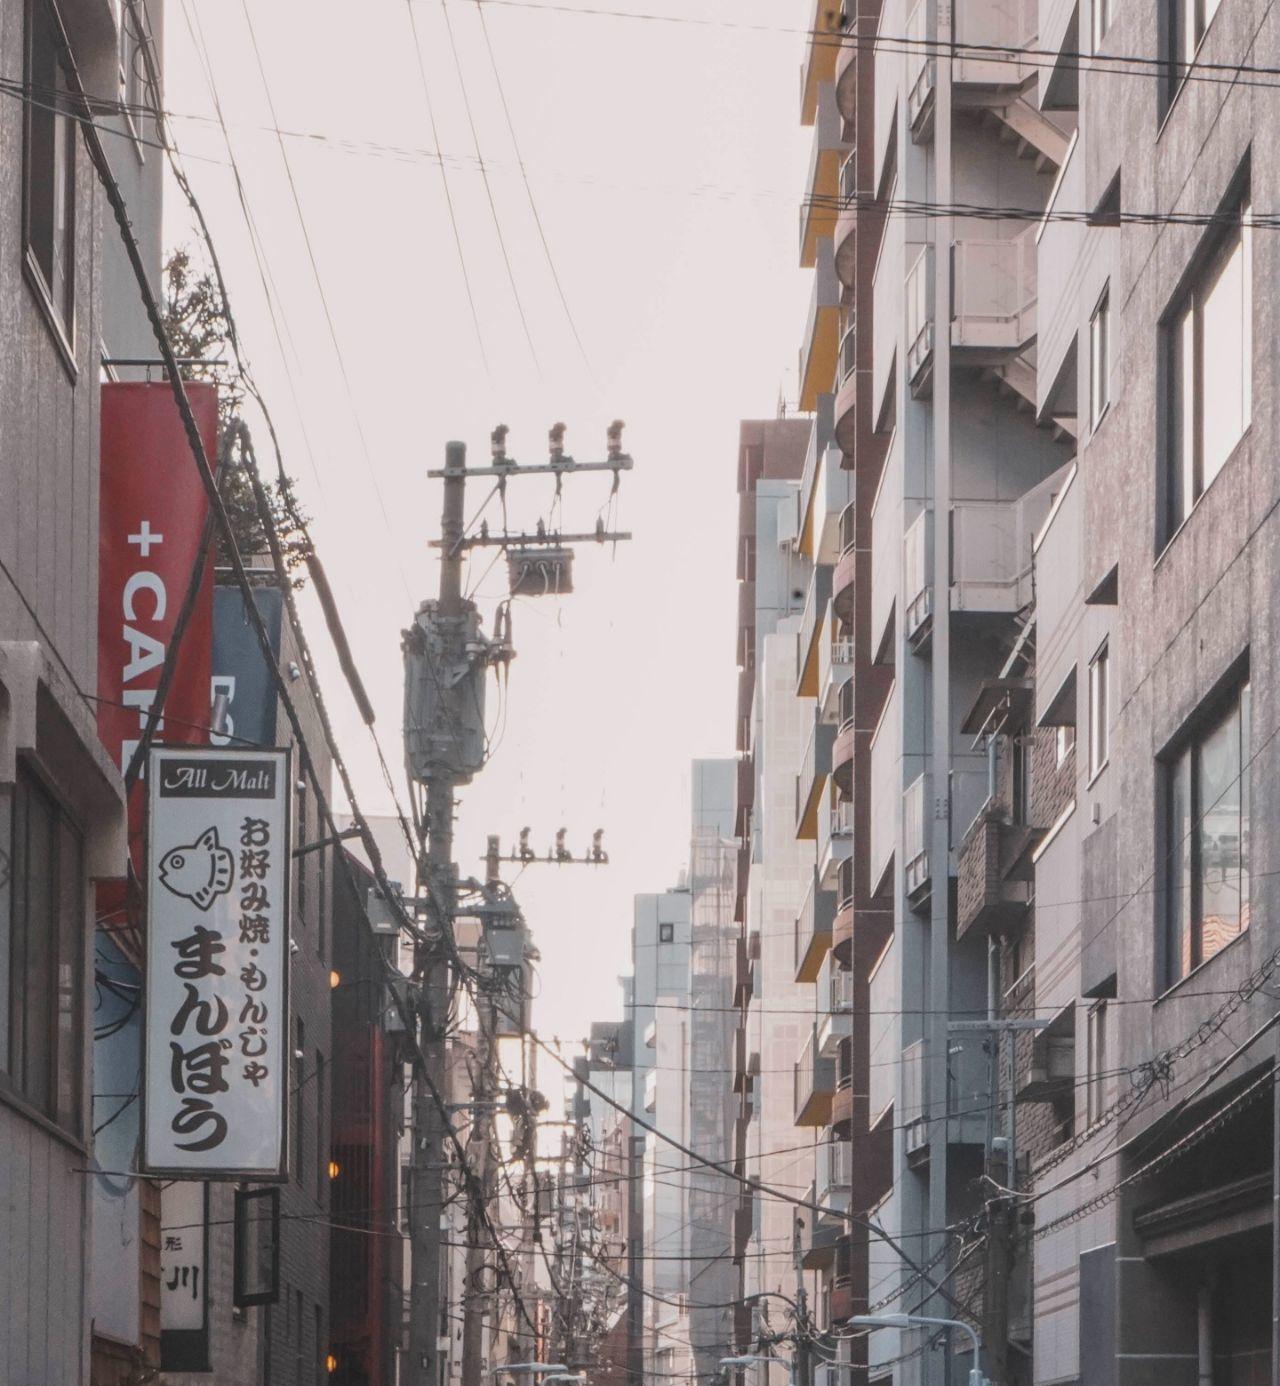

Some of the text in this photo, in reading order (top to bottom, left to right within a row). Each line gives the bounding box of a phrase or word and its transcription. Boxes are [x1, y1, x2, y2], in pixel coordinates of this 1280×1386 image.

[164, 767, 270, 791] All Malt
[238, 816, 271, 1088] お好み焼・もんじゃ
[170, 925, 232, 1152] まんぼう
[161, 1265, 200, 1300] 川
